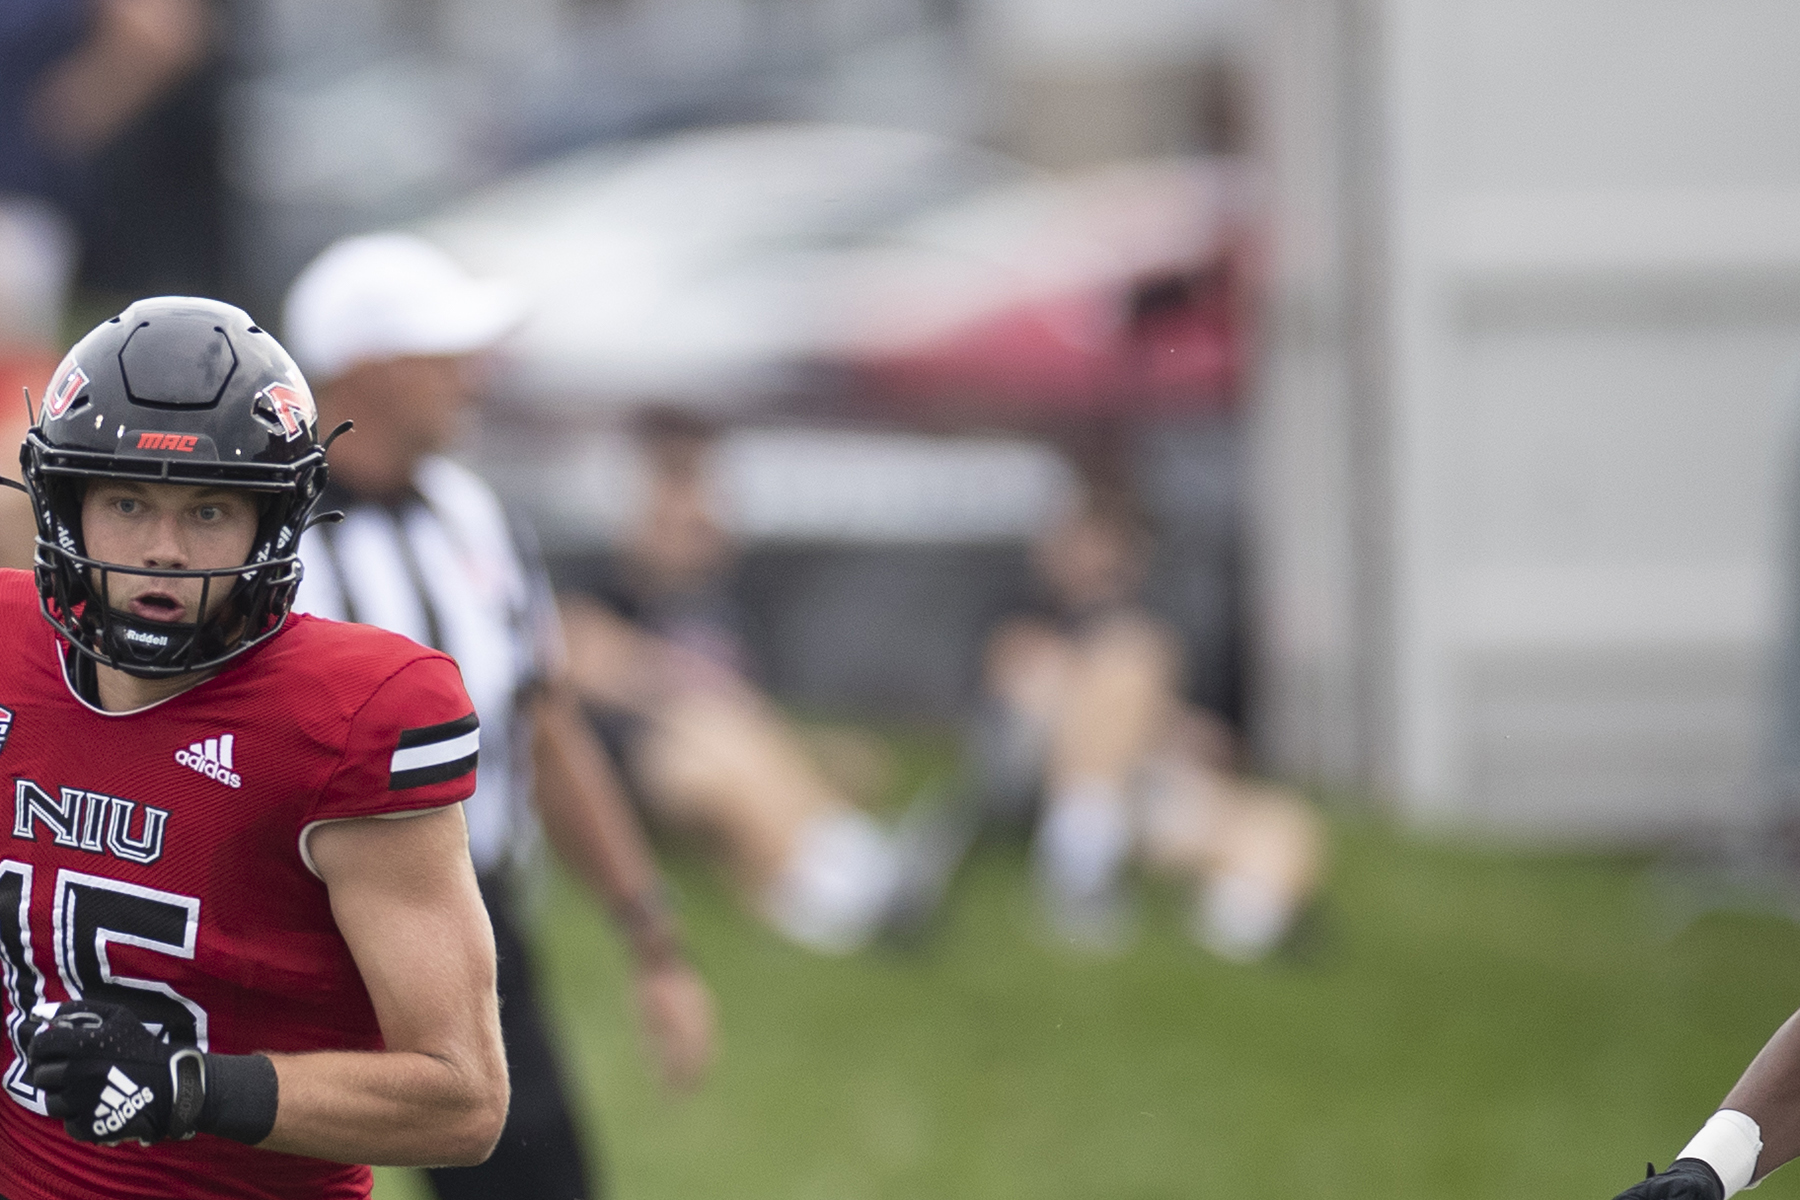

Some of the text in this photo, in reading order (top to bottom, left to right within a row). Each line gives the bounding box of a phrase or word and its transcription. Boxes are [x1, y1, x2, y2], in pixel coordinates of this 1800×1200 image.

[136, 432, 199, 453] MAC
[126, 628, 169, 646] Riddell
[174, 749, 242, 789] adidas
[12, 777, 169, 864] NIU
[92, 1085, 155, 1136] adidas
